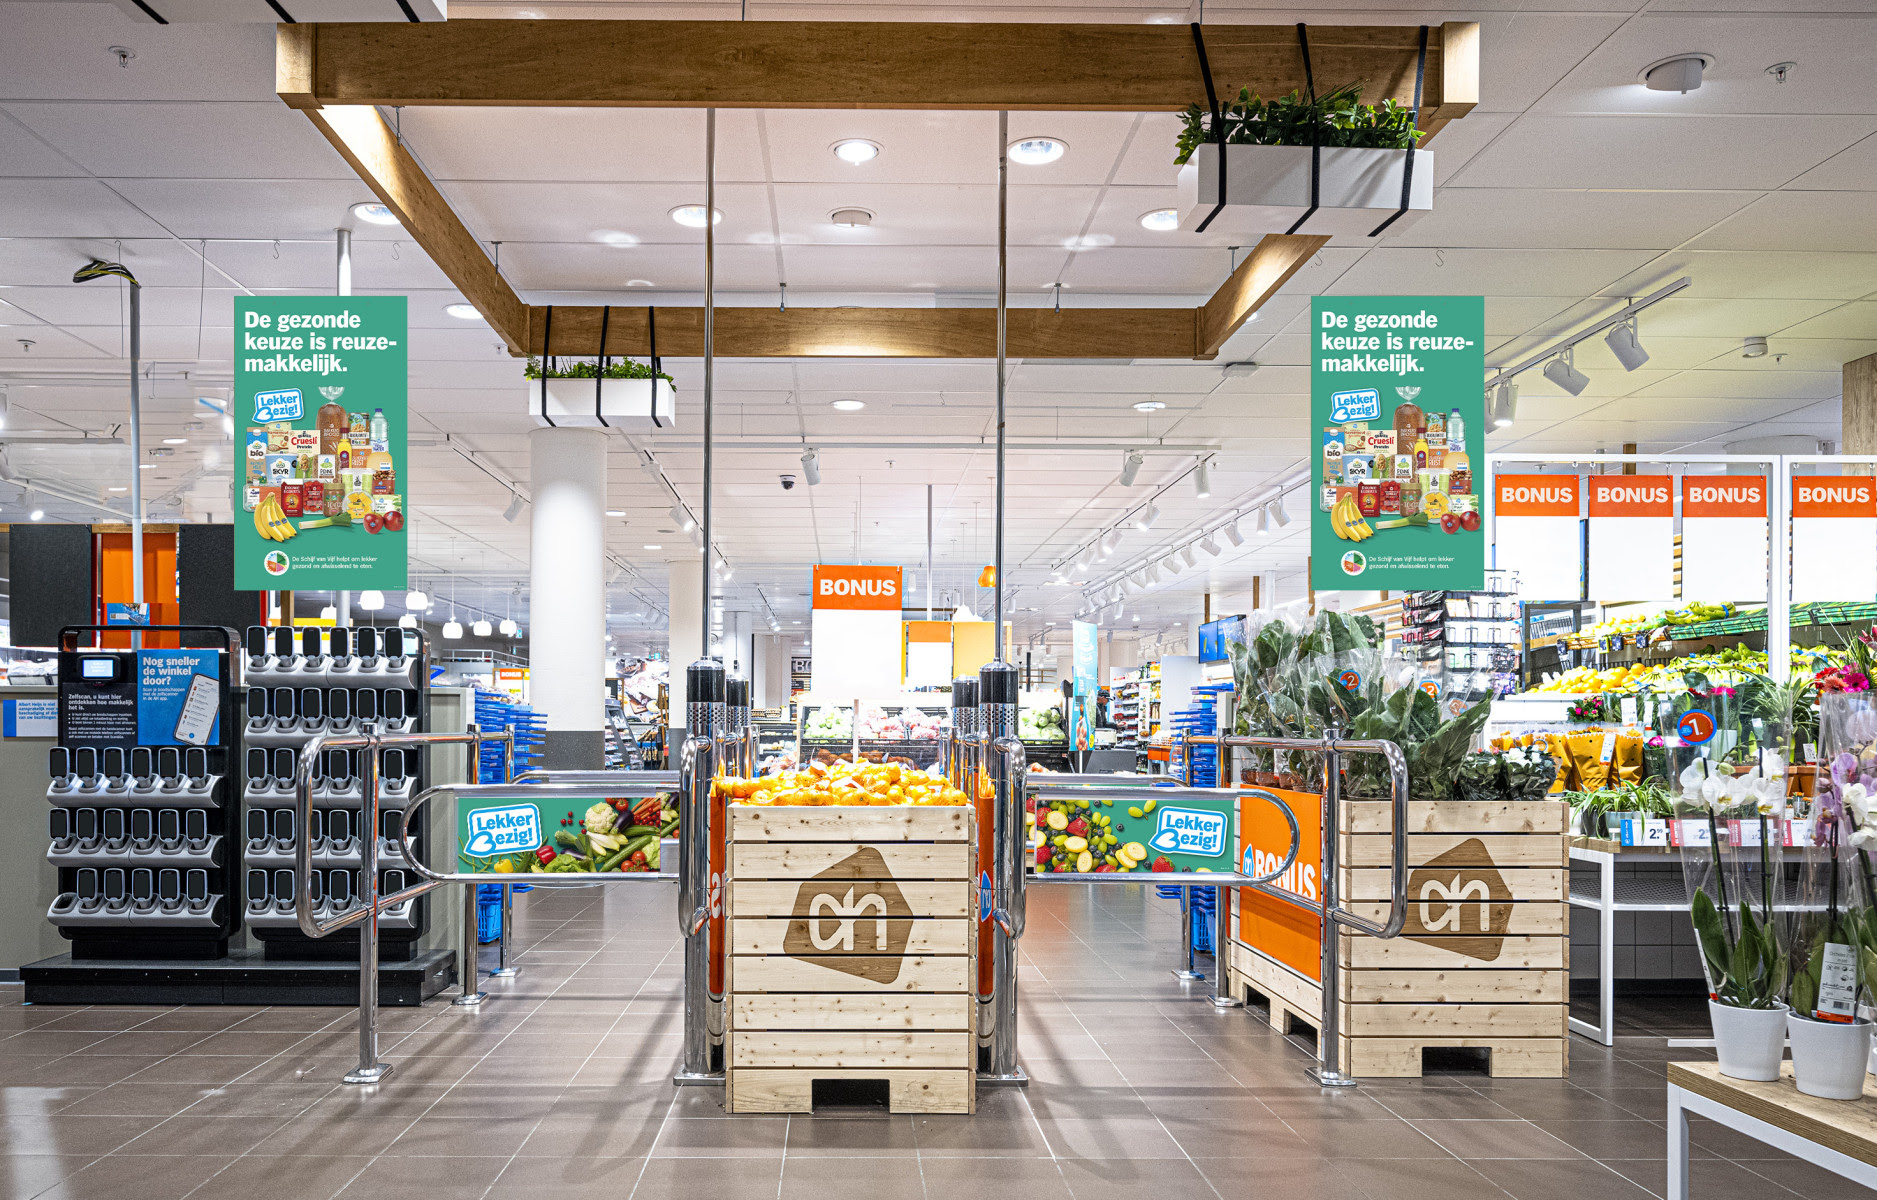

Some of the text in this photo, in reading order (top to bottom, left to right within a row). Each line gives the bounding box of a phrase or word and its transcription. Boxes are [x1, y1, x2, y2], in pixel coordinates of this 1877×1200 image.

[245, 310, 361, 332] De gezonde
[1322, 310, 1438, 332] De gezonde
[245, 332, 397, 350] keuze is reuze-
[1322, 332, 1474, 350] keuze is reuze-
[245, 354, 347, 376] makkelijk.
[1322, 354, 1424, 376] makkelijk.
[260, 394, 298, 407] Lekker
[1337, 394, 1375, 407] Lekker
[291, 437, 317, 445] Cruesli
[1368, 437, 1394, 445] Cruesli
[1501, 486, 1573, 503] BONUS
[1597, 486, 1668, 503] BONUS
[1689, 486, 1761, 503] BONUS
[1798, 486, 1870, 503] BONUS
[820, 578, 896, 597] BONUS
[143, 656, 200, 667] Nog sneller
[143, 666, 192, 676] de winkel
[143, 676, 171, 685] door?
[1688, 718, 1704, 736] 1.
[477, 814, 533, 831] Lekker
[1166, 815, 1221, 832] Lekker
[1255, 849, 1316, 900] BONUS
